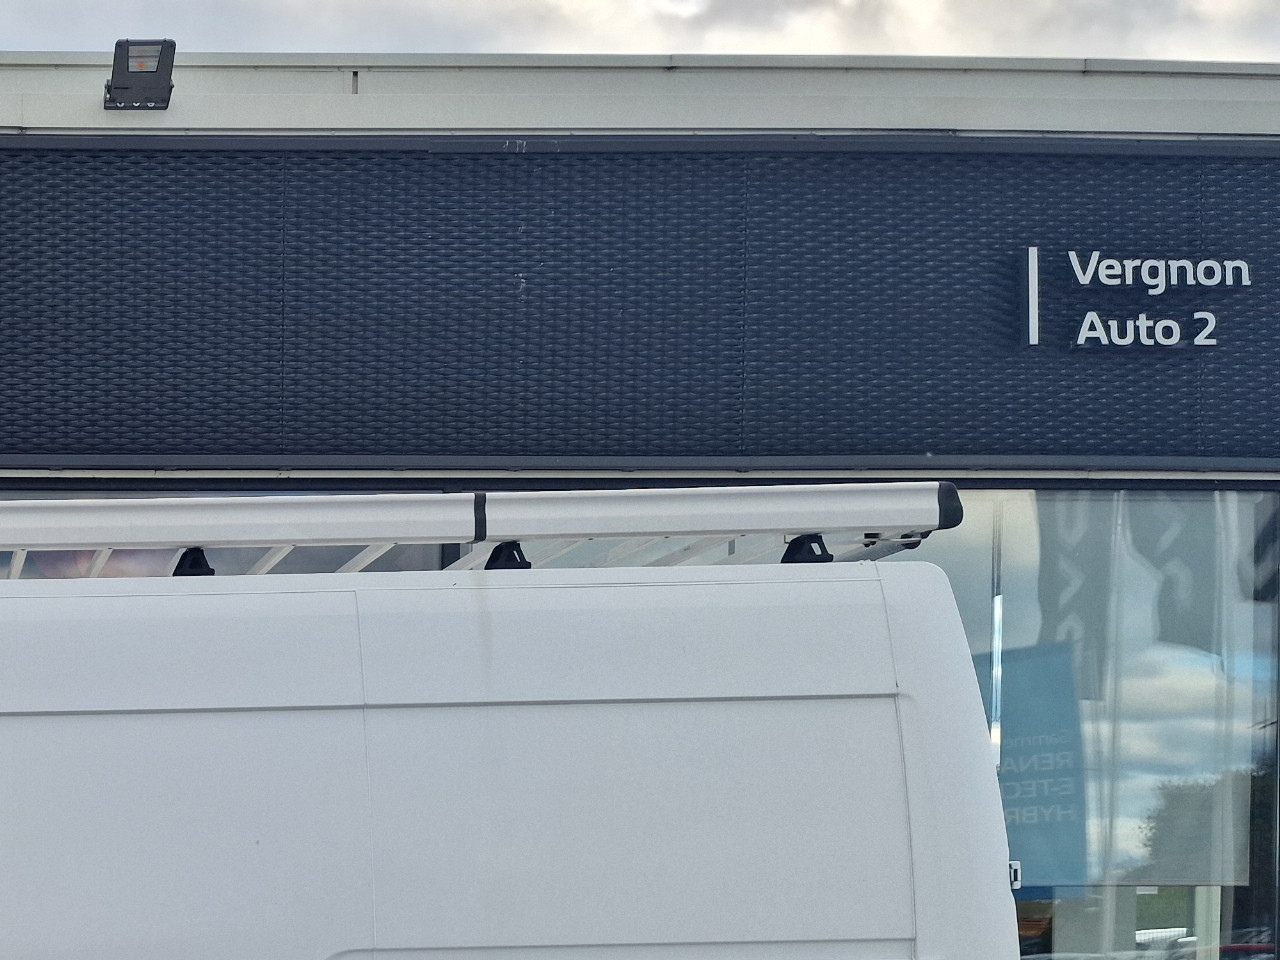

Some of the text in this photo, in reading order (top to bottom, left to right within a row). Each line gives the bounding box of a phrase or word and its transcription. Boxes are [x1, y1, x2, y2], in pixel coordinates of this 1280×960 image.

[1067, 250, 1252, 296] Vergnon
[1076, 311, 1218, 346] Auto 2
